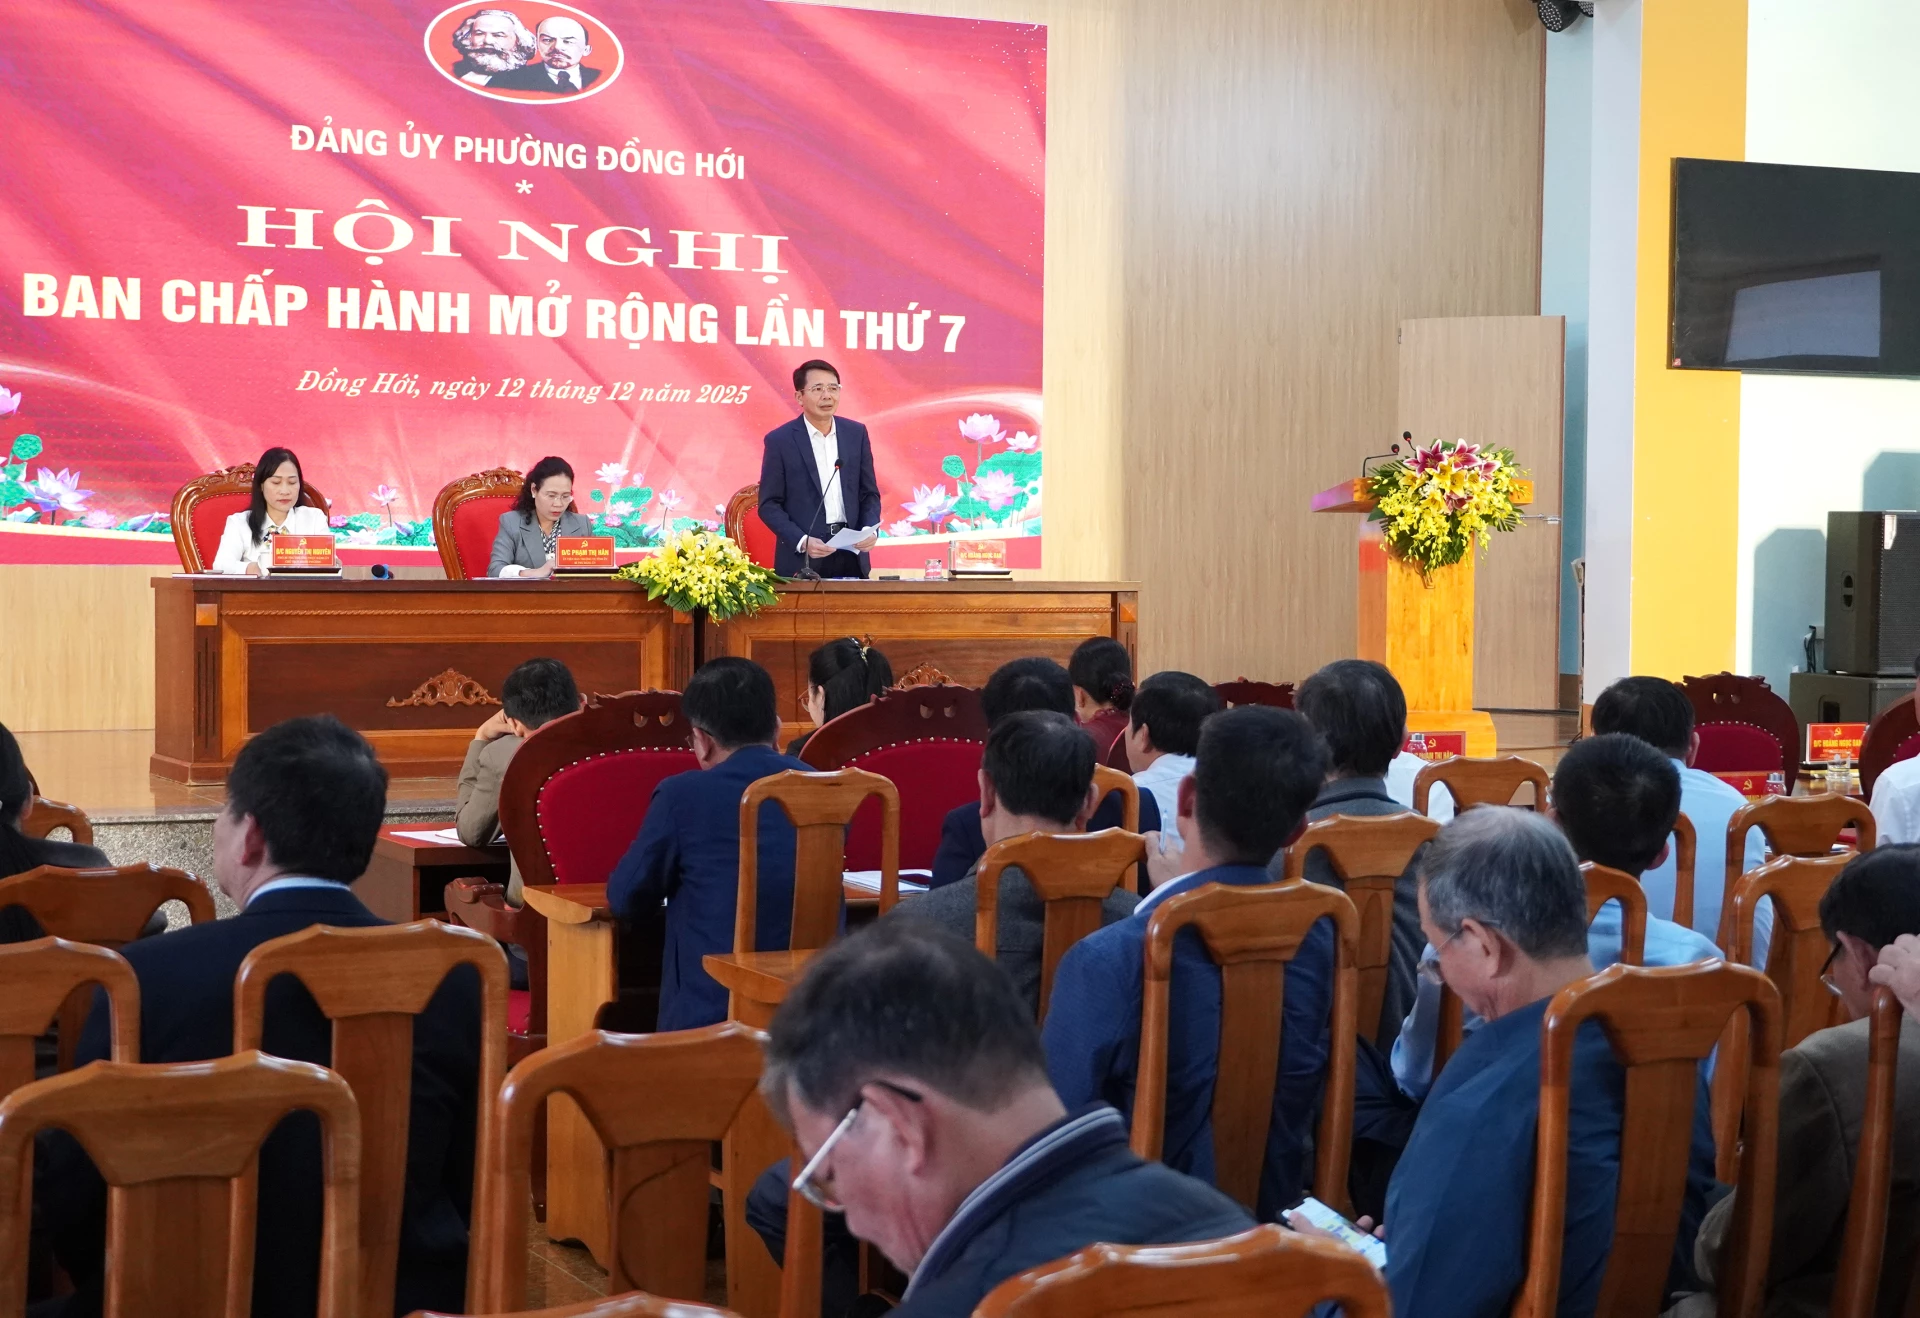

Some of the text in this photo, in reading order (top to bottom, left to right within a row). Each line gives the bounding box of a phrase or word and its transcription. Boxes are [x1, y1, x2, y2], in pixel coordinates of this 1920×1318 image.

[290, 116, 745, 179] ĐẢNG ỦY PHƯỜNG ĐỒNG HỚI
[238, 199, 789, 284] HỘI NGHỊ
[24, 269, 966, 352] BAN CHẤP HÀNH MỞ RỘNG LẦN THỨ 7
[296, 367, 752, 405] Đồng Hới, ngày 12 tháng 12 năm 2025
[571, 549, 588, 557] PHẠM
[588, 549, 597, 557] THỊ
